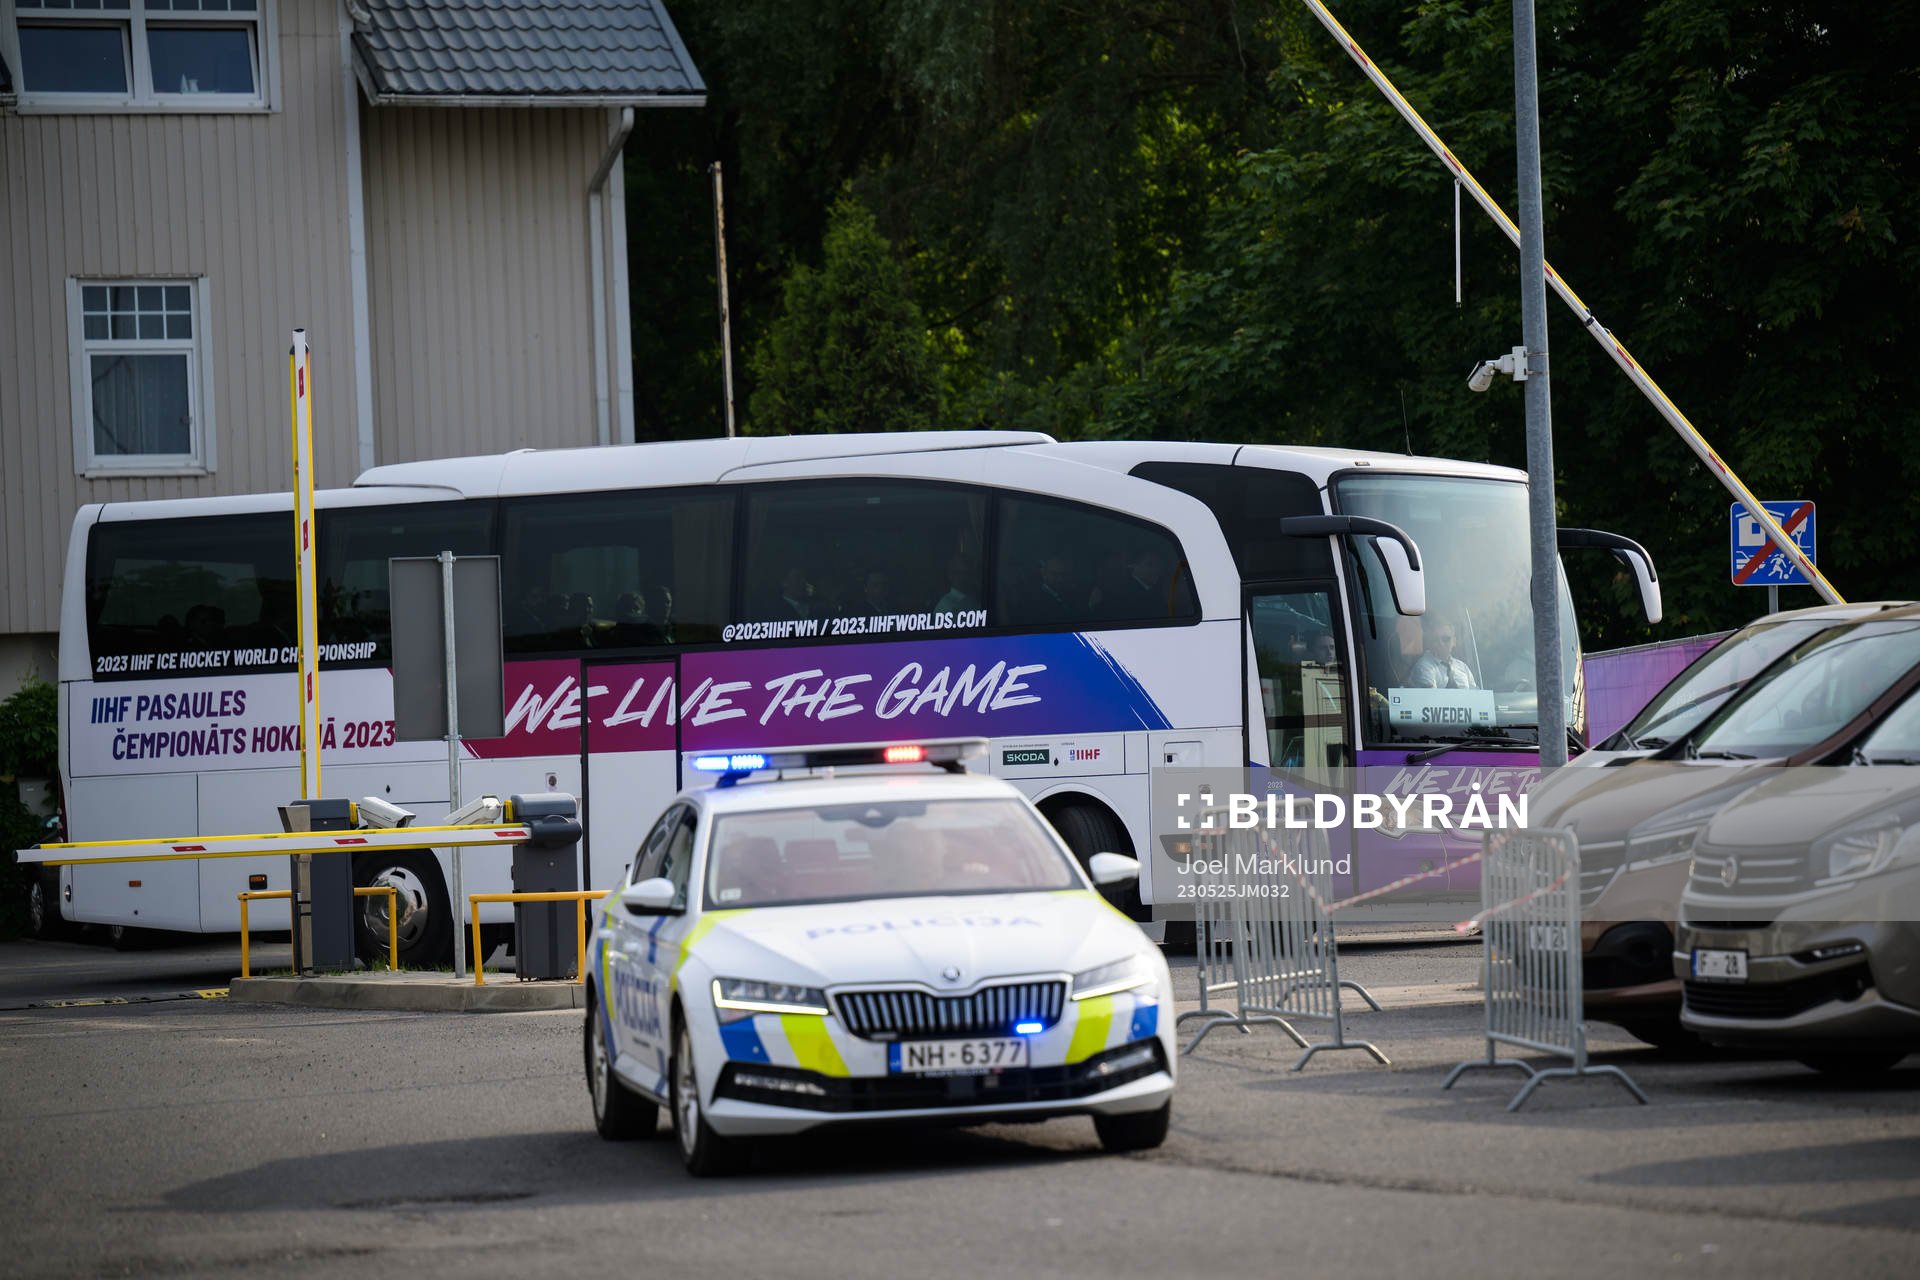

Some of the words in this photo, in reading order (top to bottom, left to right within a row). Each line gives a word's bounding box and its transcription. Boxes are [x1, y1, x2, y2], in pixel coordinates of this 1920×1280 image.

[722, 618, 818, 642] @2023IIHFWM
[820, 618, 829, 636] /
[832, 609, 988, 636] 2023.IIHFWORLDS.COM
[96, 655, 128, 673] 2023
[130, 653, 154, 671] IIHF
[156, 652, 177, 670] ICE
[180, 649, 230, 669] HOCKEY
[233, 647, 278, 666] WORLD
[280, 641, 377, 664] CHPIONSHIP
[91, 696, 132, 724] IIHF
[135, 690, 247, 721] PASAULES
[504, 675, 609, 737] WE
[603, 675, 752, 728] LIVE
[759, 668, 873, 726] THE
[875, 660, 1048, 720] GAME
[1421, 707, 1472, 724] SWEDEN
[112, 724, 247, 761] ČEMPIONĀTS
[251, 717, 336, 752] HOKĀ
[343, 720, 395, 748] 2023
[1076, 748, 1101, 760] IIHF
[1383, 763, 1450, 795] WE
[1447, 766, 1512, 795] LIVE
